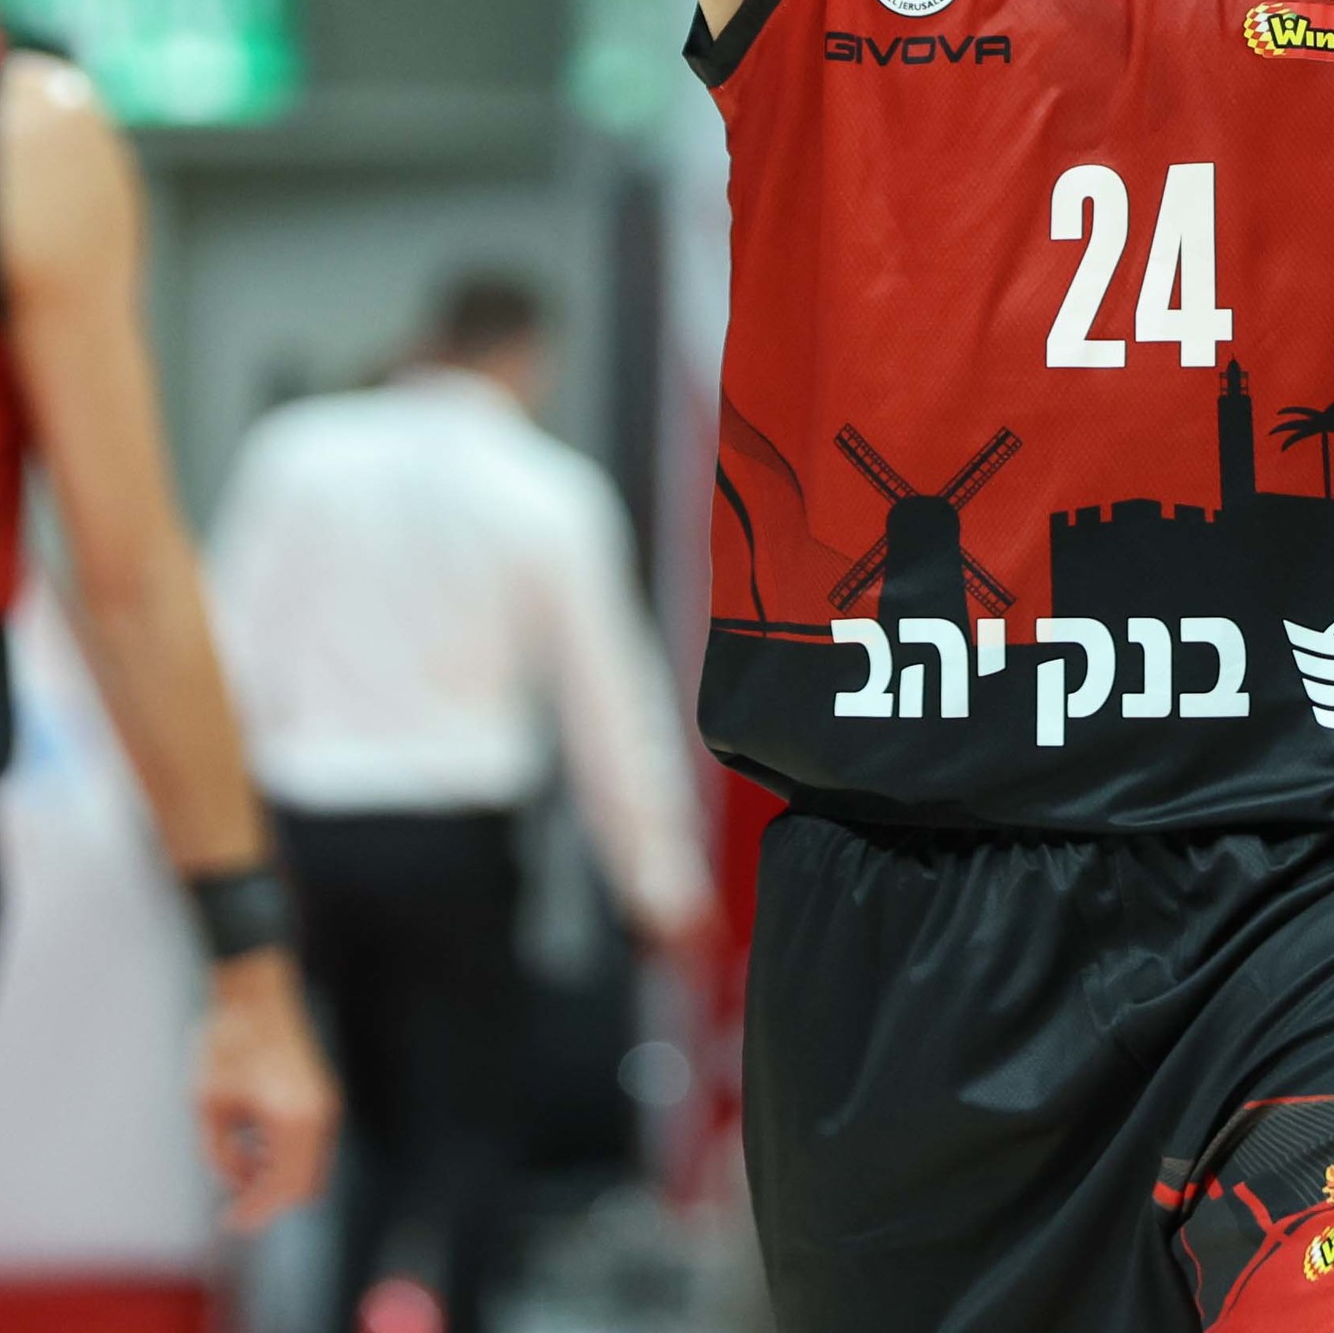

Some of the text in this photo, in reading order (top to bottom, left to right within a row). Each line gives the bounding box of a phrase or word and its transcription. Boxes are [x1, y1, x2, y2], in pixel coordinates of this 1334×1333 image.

[824, 31, 1012, 67] GIVOVA
[1045, 161, 1234, 369] 24
[830, 616, 1251, 747] בנק יהב
